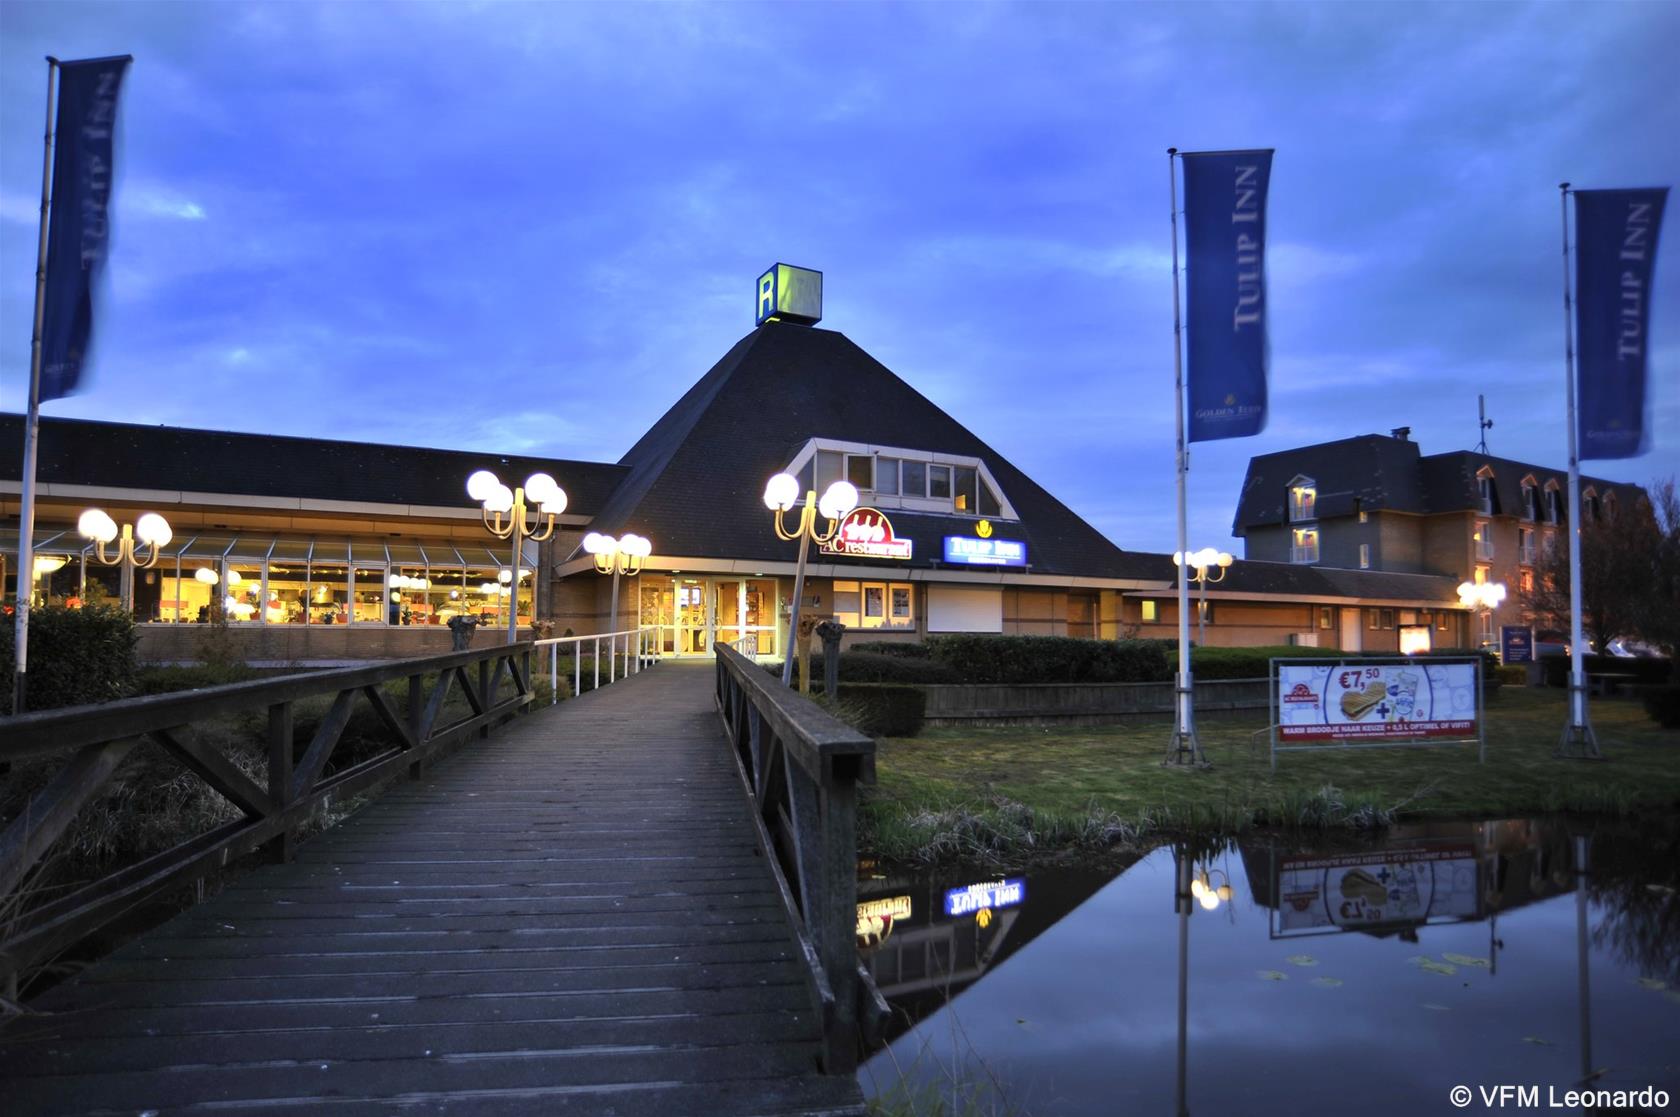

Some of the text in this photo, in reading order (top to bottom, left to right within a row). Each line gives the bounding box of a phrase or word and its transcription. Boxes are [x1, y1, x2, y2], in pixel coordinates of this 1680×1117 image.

[1232, 164, 1261, 332] TULIP INN
[1617, 202, 1652, 362] TULIP INN
